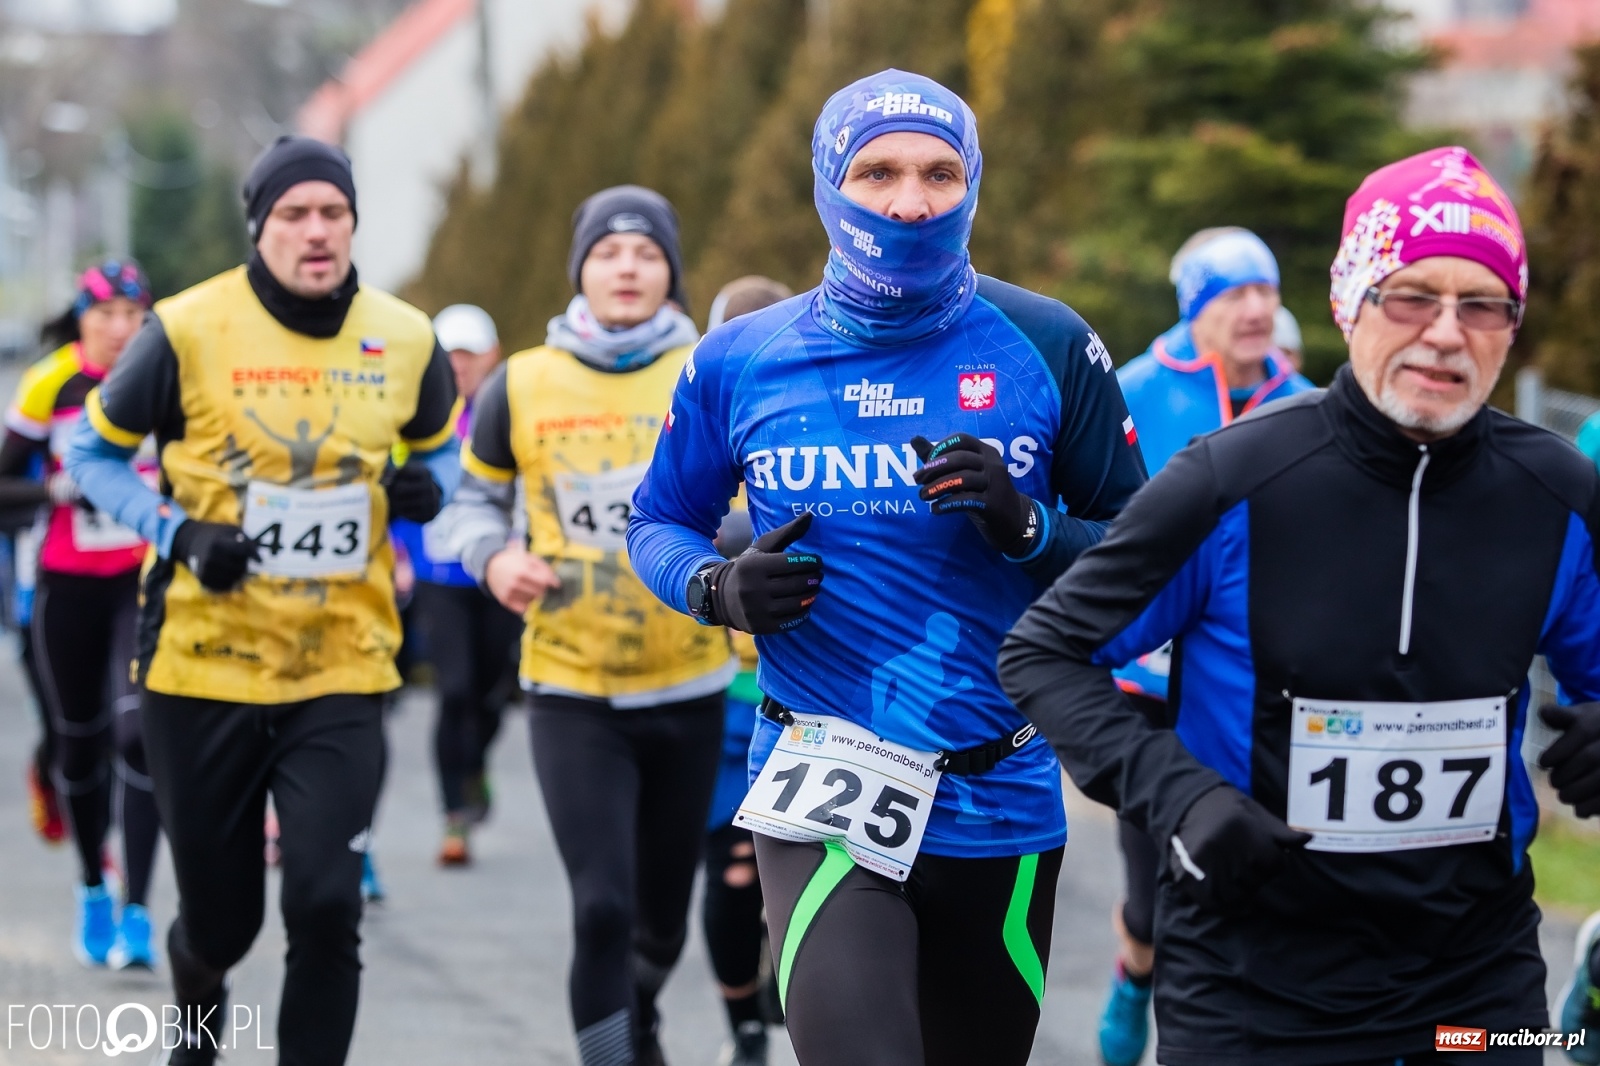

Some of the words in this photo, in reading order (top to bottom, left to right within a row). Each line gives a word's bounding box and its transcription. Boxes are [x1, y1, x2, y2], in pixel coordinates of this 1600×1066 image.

[1409, 201, 1470, 237] XIII
[231, 366, 321, 386] ENERGY
[331, 369, 385, 386] TEAM
[747, 435, 1039, 491] RUNNS
[928, 477, 963, 495] BROOKLYN
[254, 521, 359, 557] 443
[831, 733, 934, 779] www.personalbest.pl
[771, 762, 920, 849] 125
[1309, 756, 1491, 823] 187
